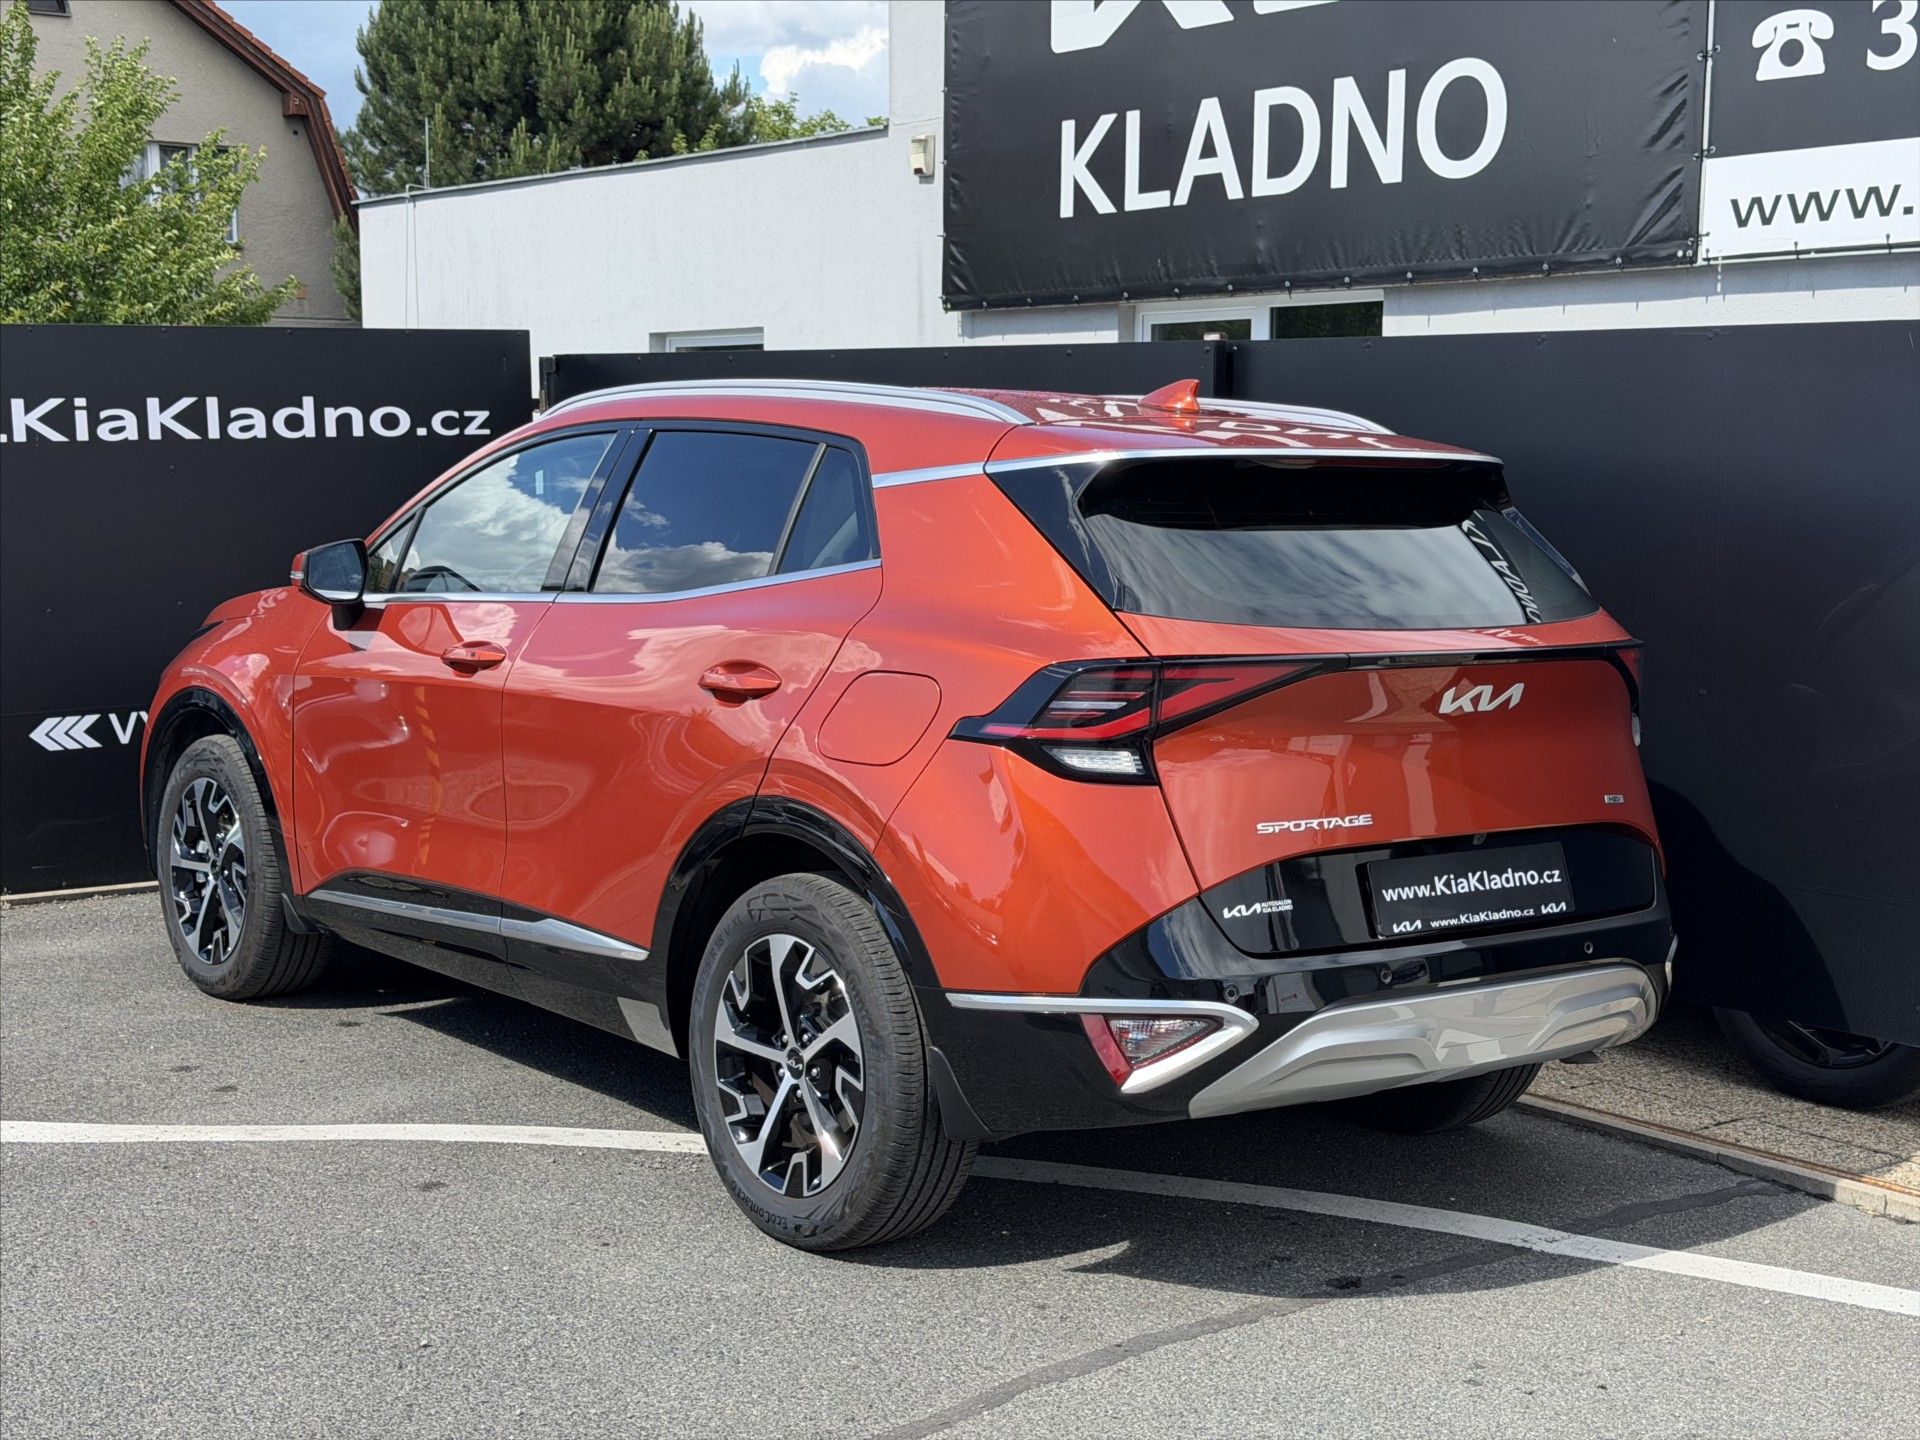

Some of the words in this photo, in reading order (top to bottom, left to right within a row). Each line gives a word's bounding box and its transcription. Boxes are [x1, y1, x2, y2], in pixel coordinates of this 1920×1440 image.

[1866, 0, 1918, 71] 3
[1059, 57, 1507, 218] KLADNO
[1730, 184, 1914, 228] www.
[1438, 683, 1525, 714] KIA
[108, 711, 148, 744] V
[1257, 814, 1373, 834] SPORTAGE
[1382, 868, 1562, 902] www.KiaKladno.cz
[1223, 902, 1261, 919] KIA
[1393, 919, 1421, 933] KIA
[1430, 907, 1534, 928] www.KiaKladno.cz
[1541, 902, 1566, 914] KIA
